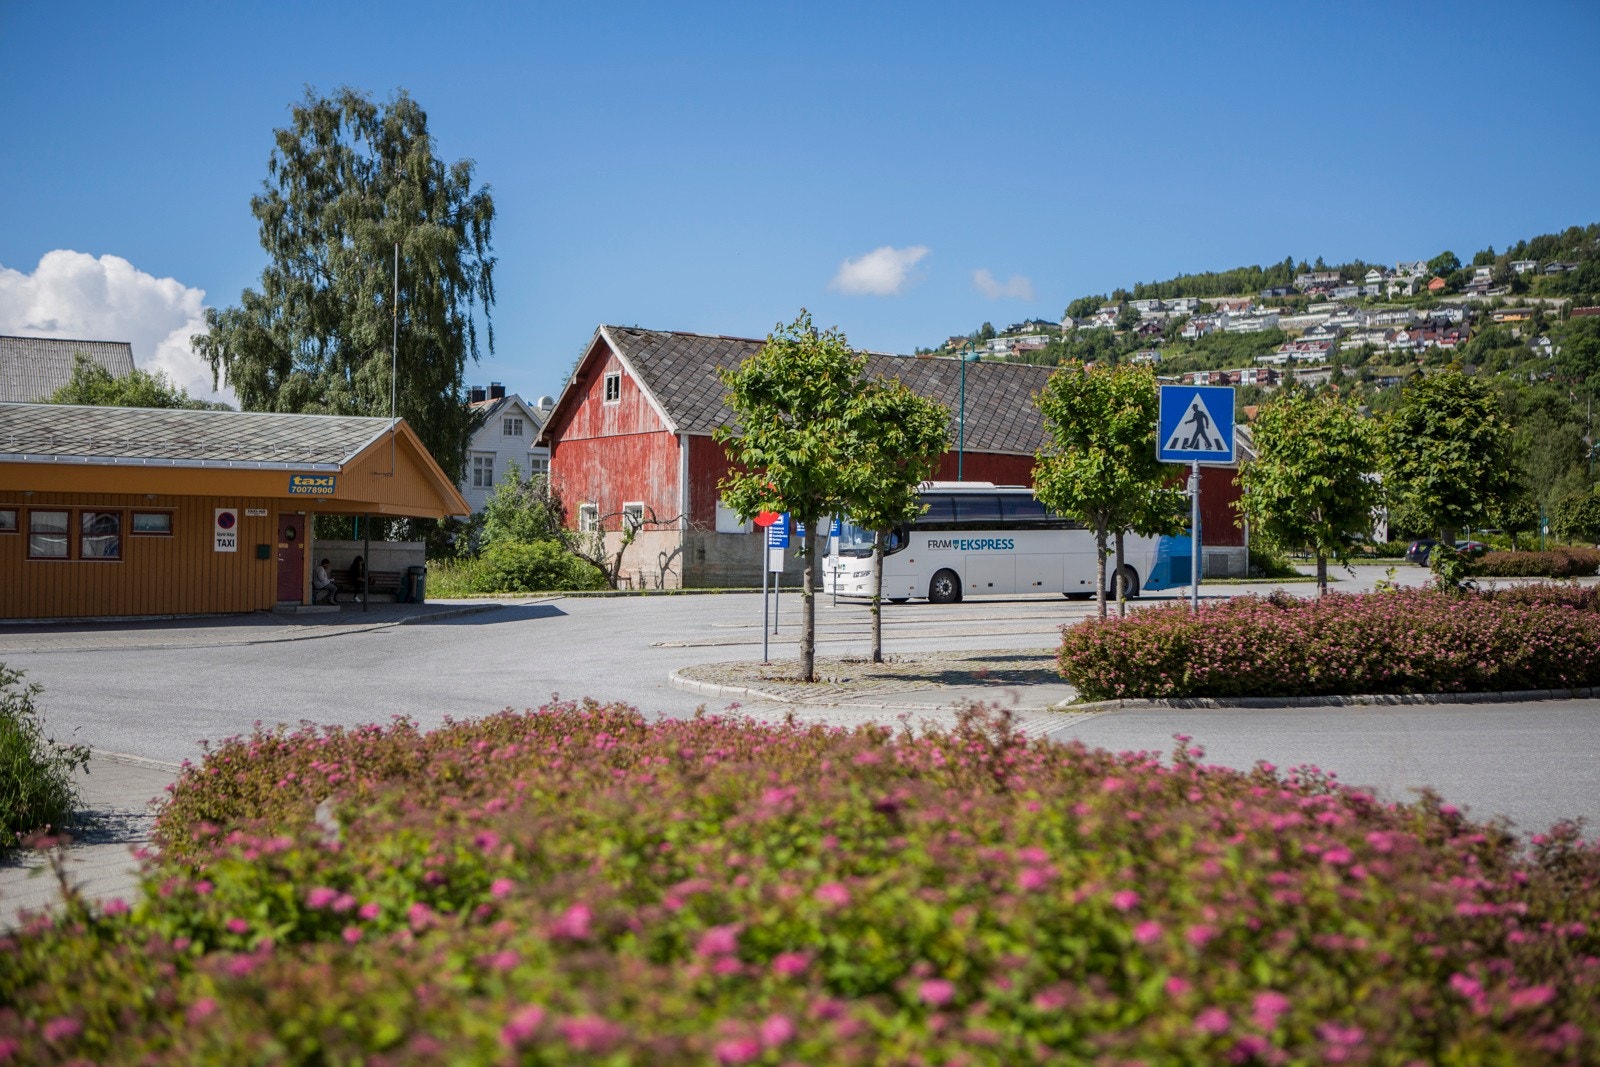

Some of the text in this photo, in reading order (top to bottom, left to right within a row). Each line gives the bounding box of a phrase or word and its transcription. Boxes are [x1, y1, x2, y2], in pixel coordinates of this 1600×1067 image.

[293, 476, 334, 486] taxi
[291, 485, 333, 494] 70078900
[216, 538, 235, 547] TAXI
[928, 538, 1015, 551] FRAM EKSPRESS
